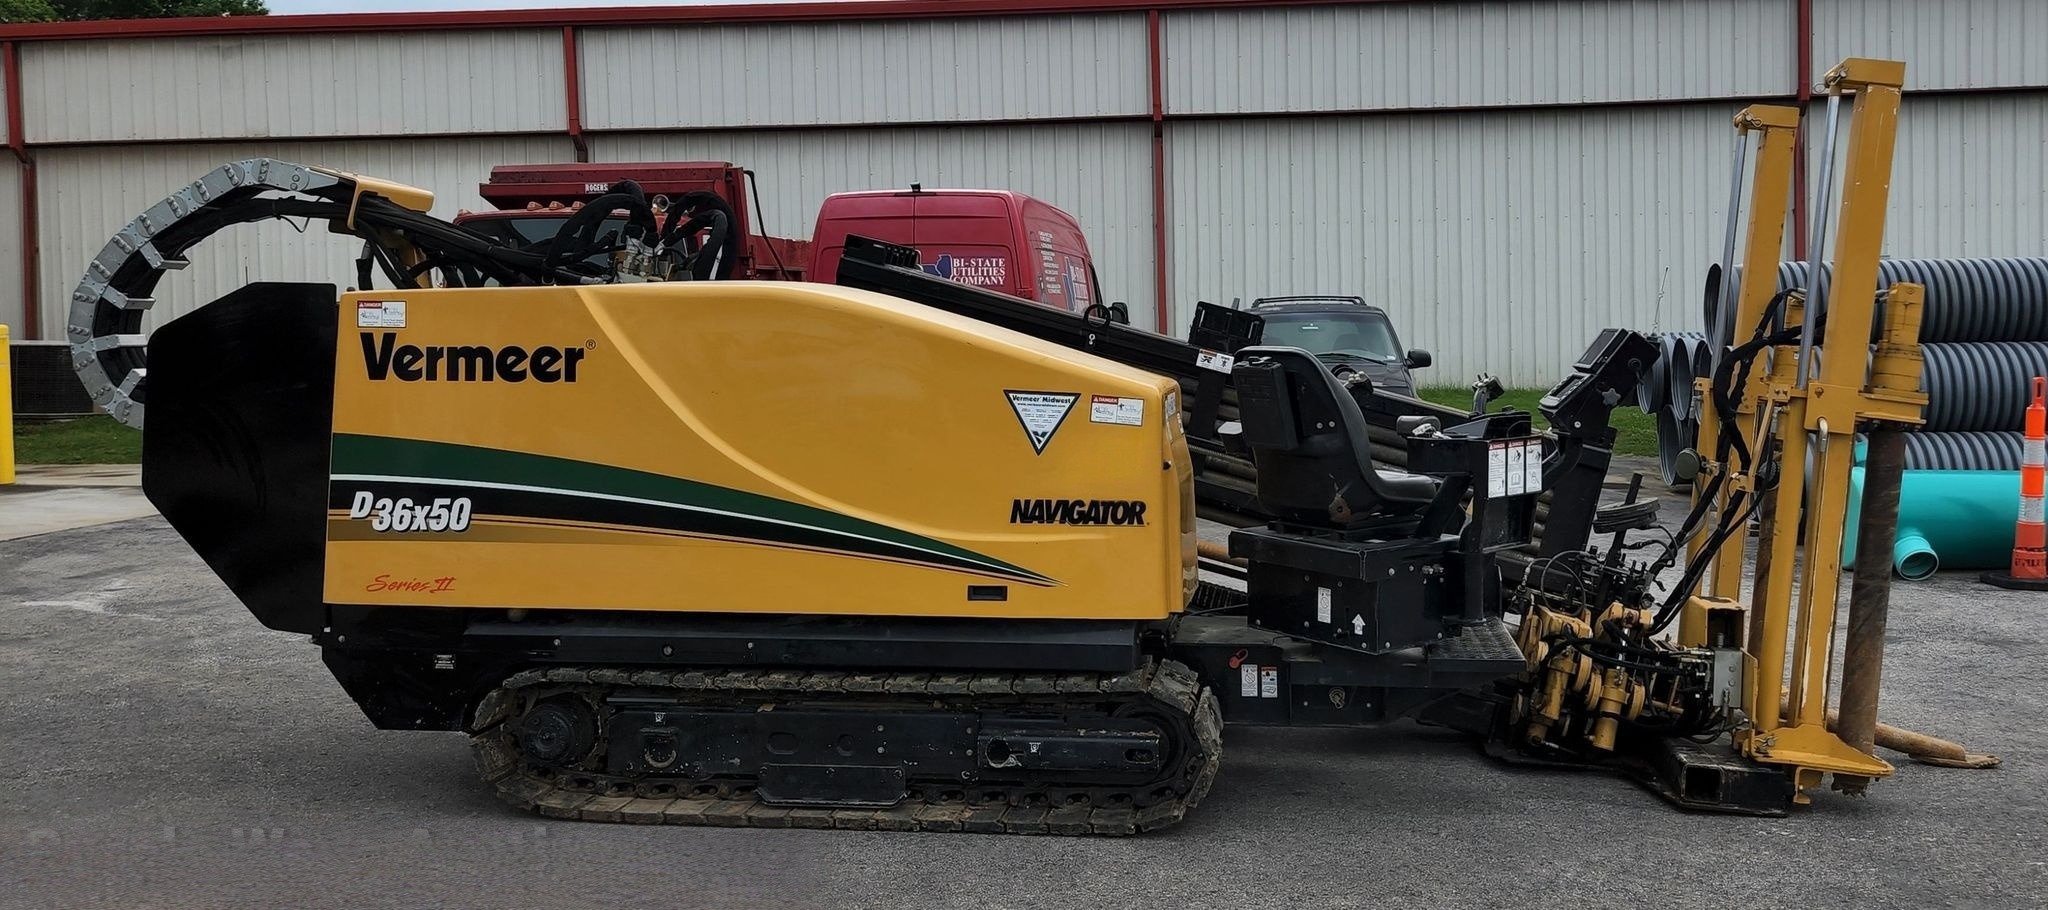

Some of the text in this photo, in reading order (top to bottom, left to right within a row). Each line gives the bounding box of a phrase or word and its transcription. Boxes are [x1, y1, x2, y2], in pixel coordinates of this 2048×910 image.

[953, 258, 1005, 267] BI-STATE
[953, 267, 1005, 276] UTILITIES
[953, 275, 1005, 285] COMPANY
[350, 491, 472, 532] D36x50
[1010, 499, 1146, 525] NAVIGATOR
[366, 574, 431, 593] Series
